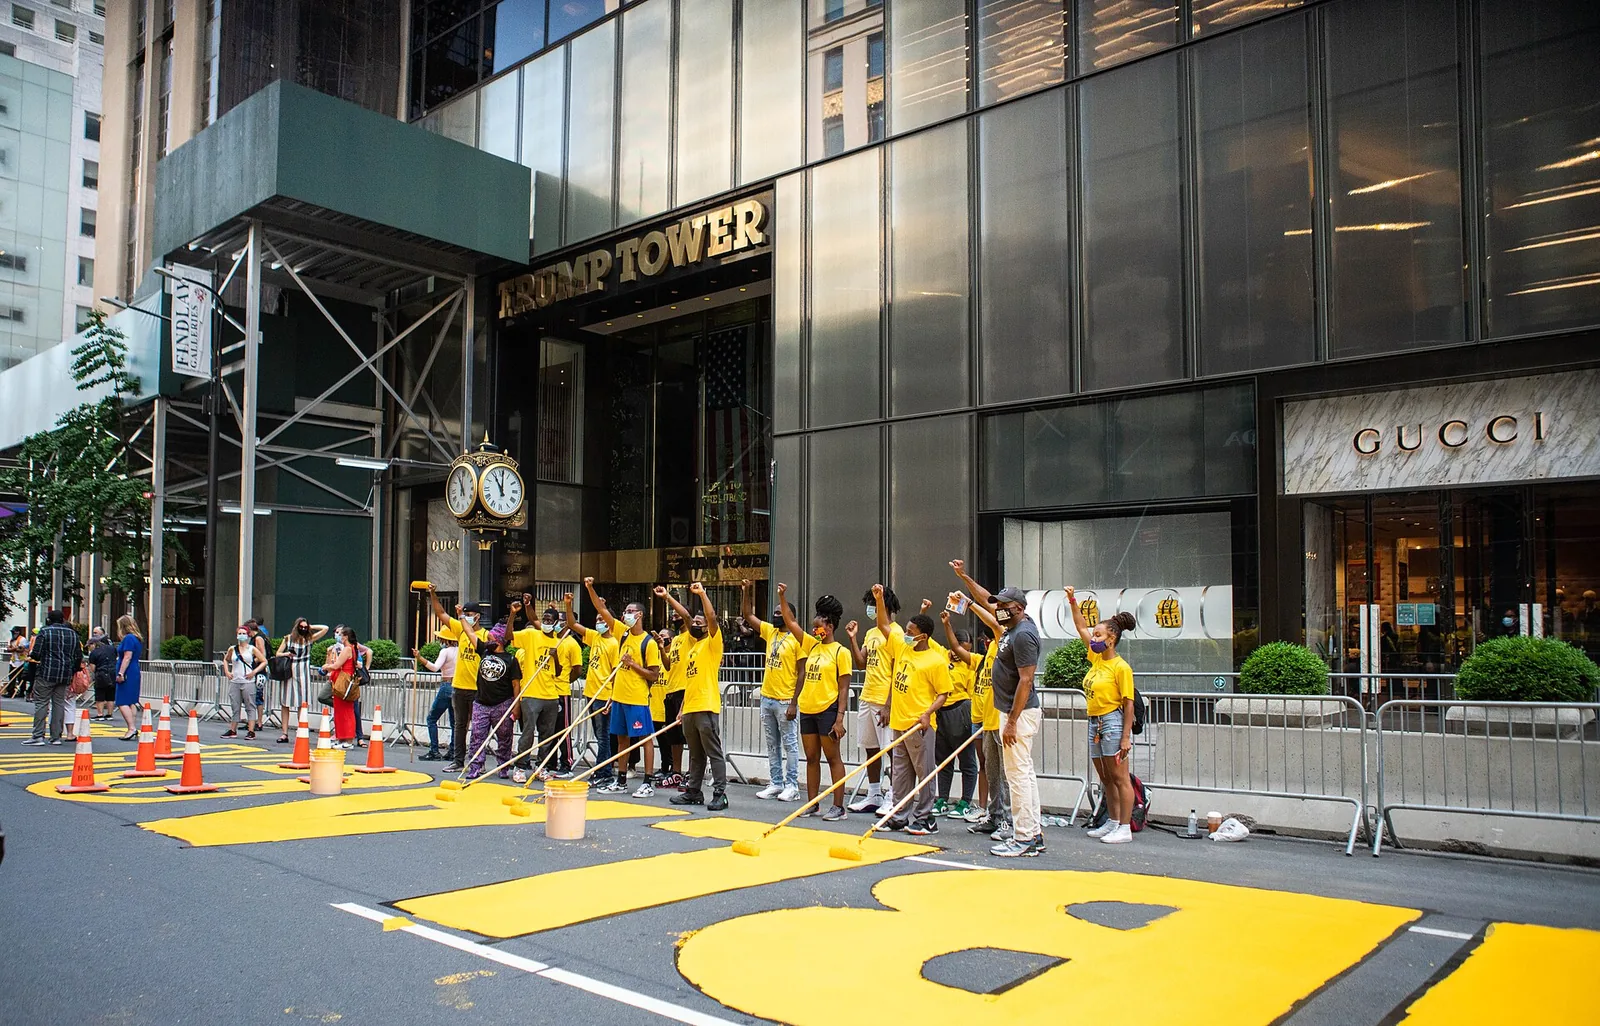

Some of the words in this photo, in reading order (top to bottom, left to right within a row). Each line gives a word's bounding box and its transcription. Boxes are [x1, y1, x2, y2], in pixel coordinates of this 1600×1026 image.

[499, 249, 613, 320] TRUMP
[616, 199, 768, 283] TOWER
[176, 283, 189, 367] FINDLAY
[190, 304, 199, 369] GALLERIES
[1353, 411, 1543, 455] GUCCI
